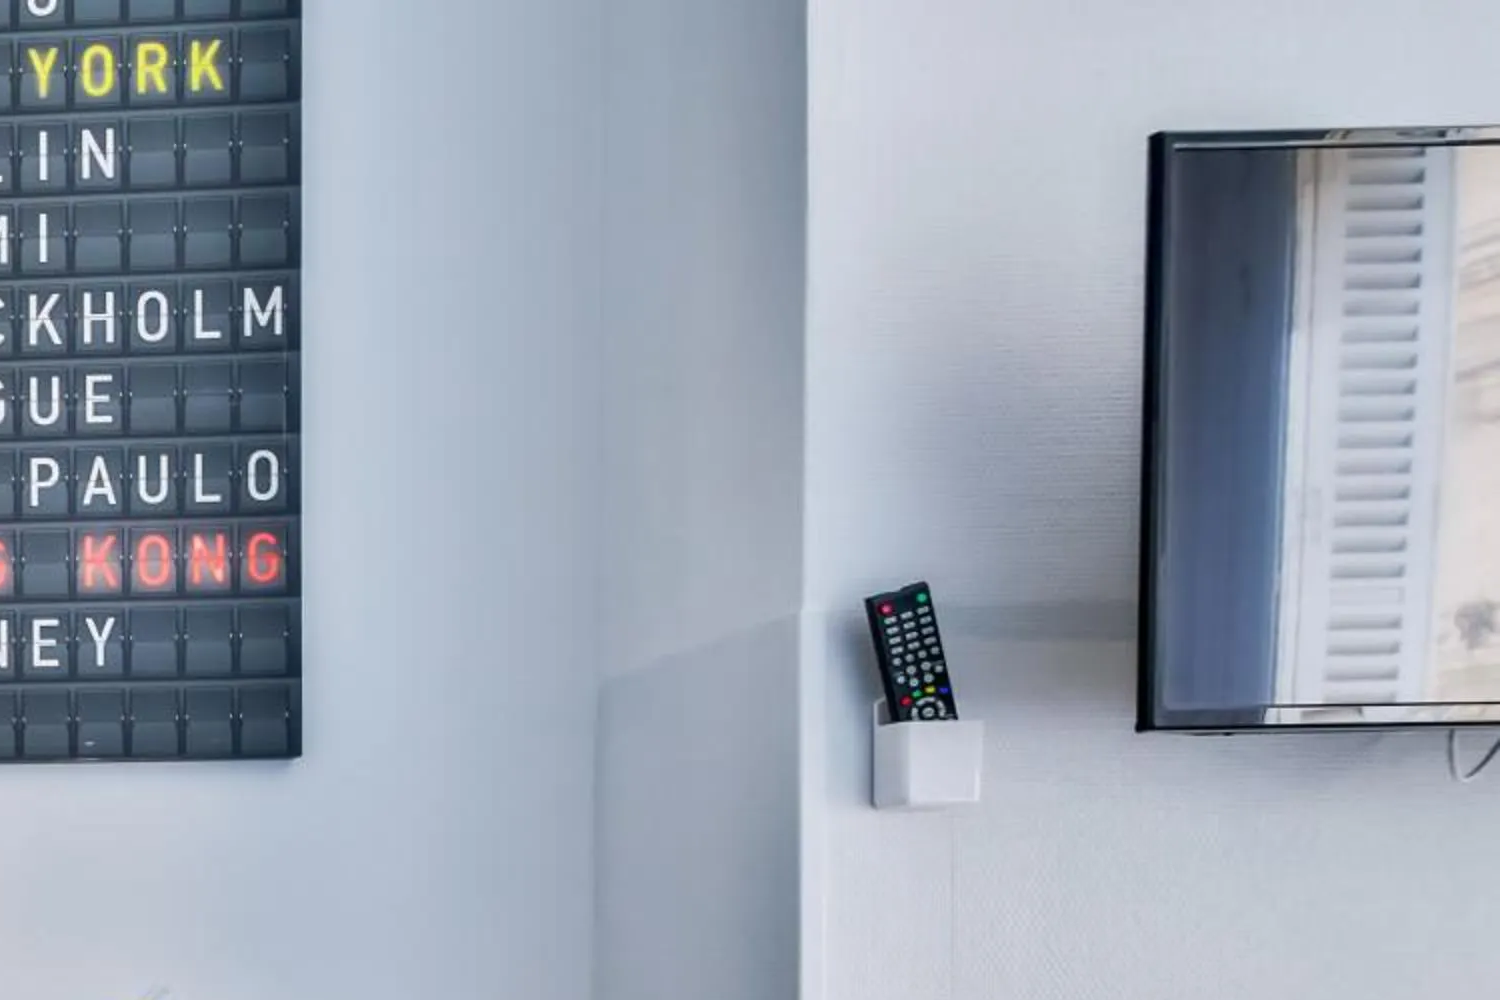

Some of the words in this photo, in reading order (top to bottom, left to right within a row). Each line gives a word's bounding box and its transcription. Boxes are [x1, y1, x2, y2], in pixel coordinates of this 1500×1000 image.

[28, 40, 223, 98] YORK
[29, 450, 279, 508] PAULO
[83, 532, 282, 588] KONG
